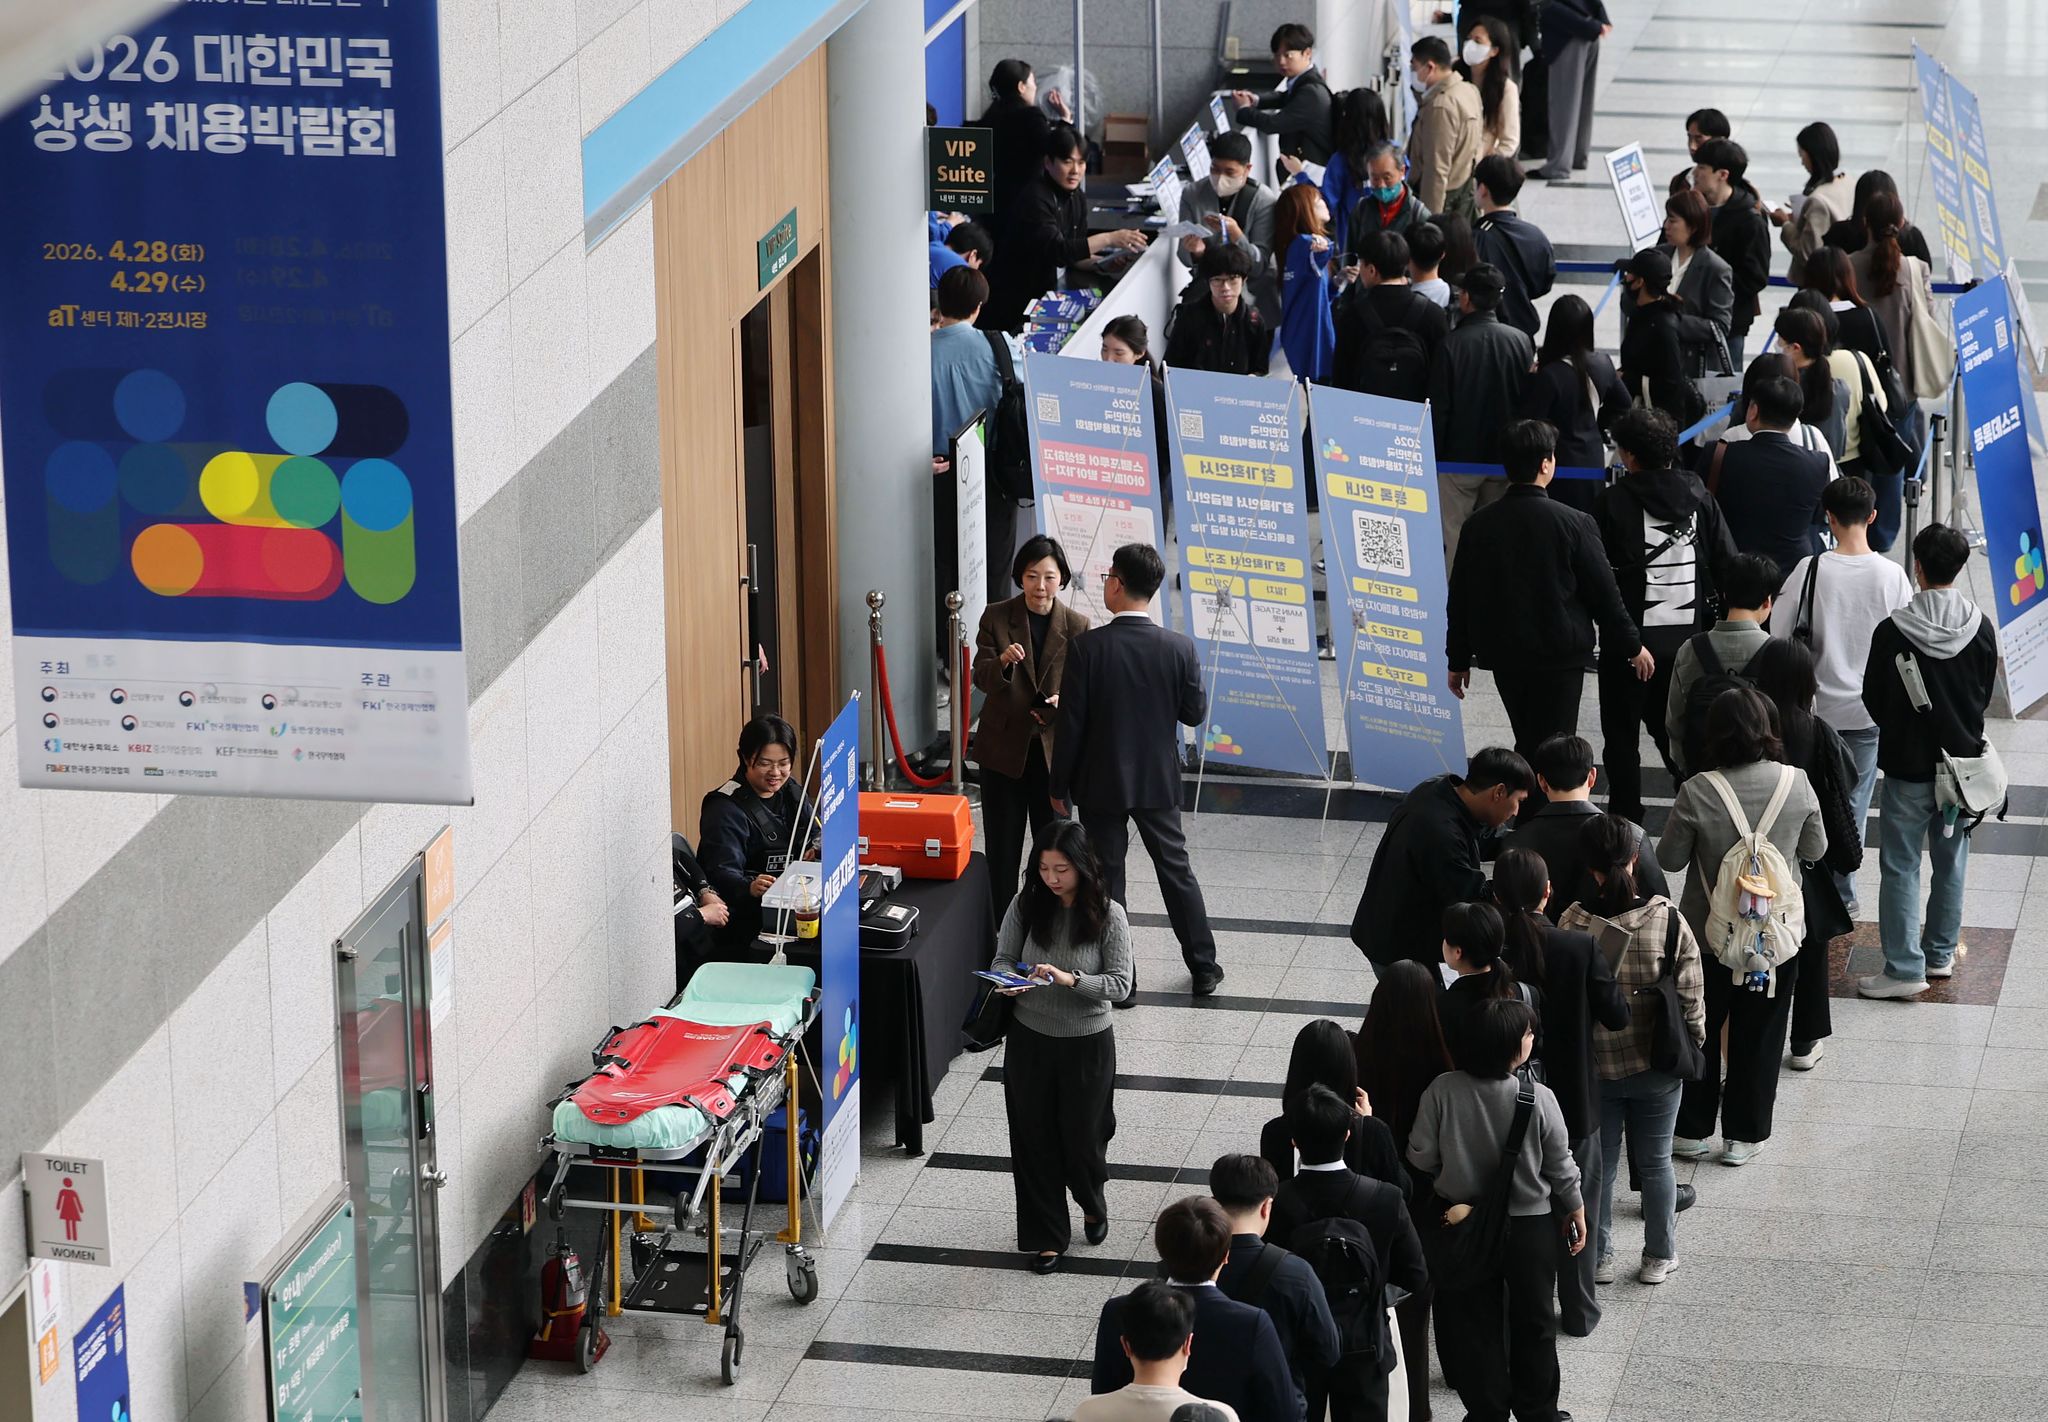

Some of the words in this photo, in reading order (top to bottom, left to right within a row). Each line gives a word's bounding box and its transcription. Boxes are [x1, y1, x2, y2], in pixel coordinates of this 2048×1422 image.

[46, 34, 180, 83] 026
[194, 34, 393, 88] 대한민국
[30, 94, 132, 152] 상생
[147, 101, 396, 157] 채용박람회
[945, 140, 977, 157] VIP
[937, 165, 986, 183] Suite
[940, 194, 955, 203] 내빈
[43, 243, 103, 261] 2026.
[109, 240, 205, 262] 4.28(화)
[110, 271, 205, 293] 4.29(수)
[1974, 405, 2020, 452] 등록데스크
[361, 672, 391, 688] 주관
[363, 701, 381, 710] FKI
[186, 722, 205, 732] FKI
[128, 744, 152, 753] KBIZ
[216, 747, 236, 757] KEF
[824, 844, 856, 915] 의료지원
[45, 1159, 88, 1175] TOILET
[50, 1247, 96, 1262] WOMEN
